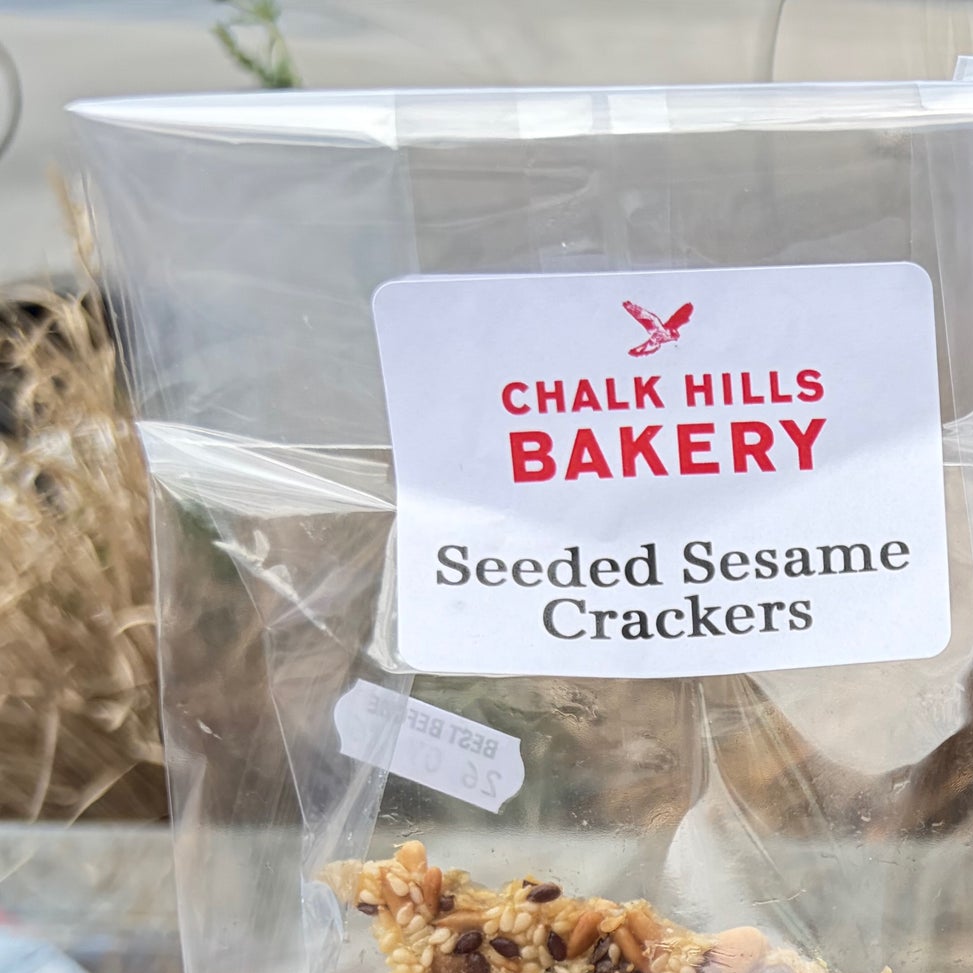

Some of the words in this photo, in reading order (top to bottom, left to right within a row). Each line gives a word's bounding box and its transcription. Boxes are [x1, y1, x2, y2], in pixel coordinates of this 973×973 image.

[502, 376, 664, 415] CHALK
[685, 369, 825, 406] HILLS
[508, 418, 827, 483] BAKERY
[435, 543, 663, 589] Seeded
[682, 539, 910, 585] Sesame
[542, 594, 813, 640] Crackers
